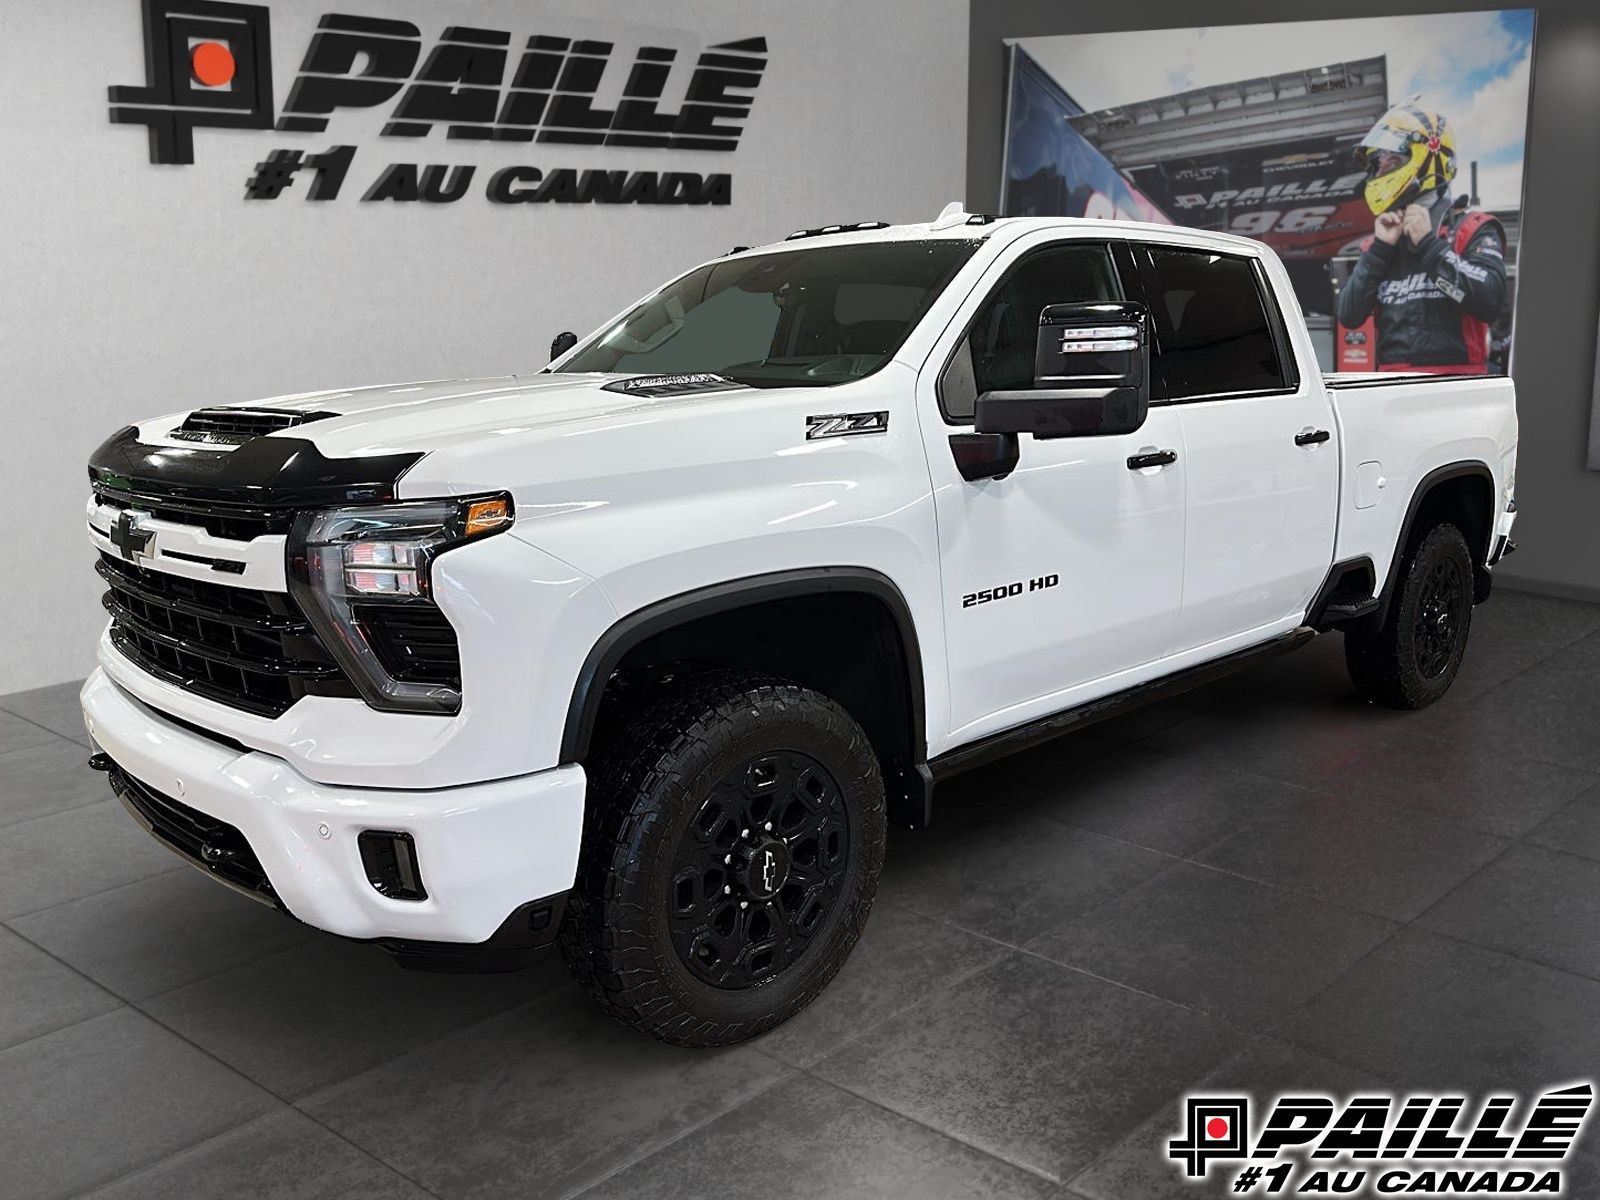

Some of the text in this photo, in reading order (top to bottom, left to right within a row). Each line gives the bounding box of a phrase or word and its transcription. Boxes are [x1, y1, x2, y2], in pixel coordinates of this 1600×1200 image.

[274, 13, 769, 152] PAILLÉ
[243, 145, 732, 206] #1 AU CANADA
[962, 574, 1059, 609] 2500 HD
